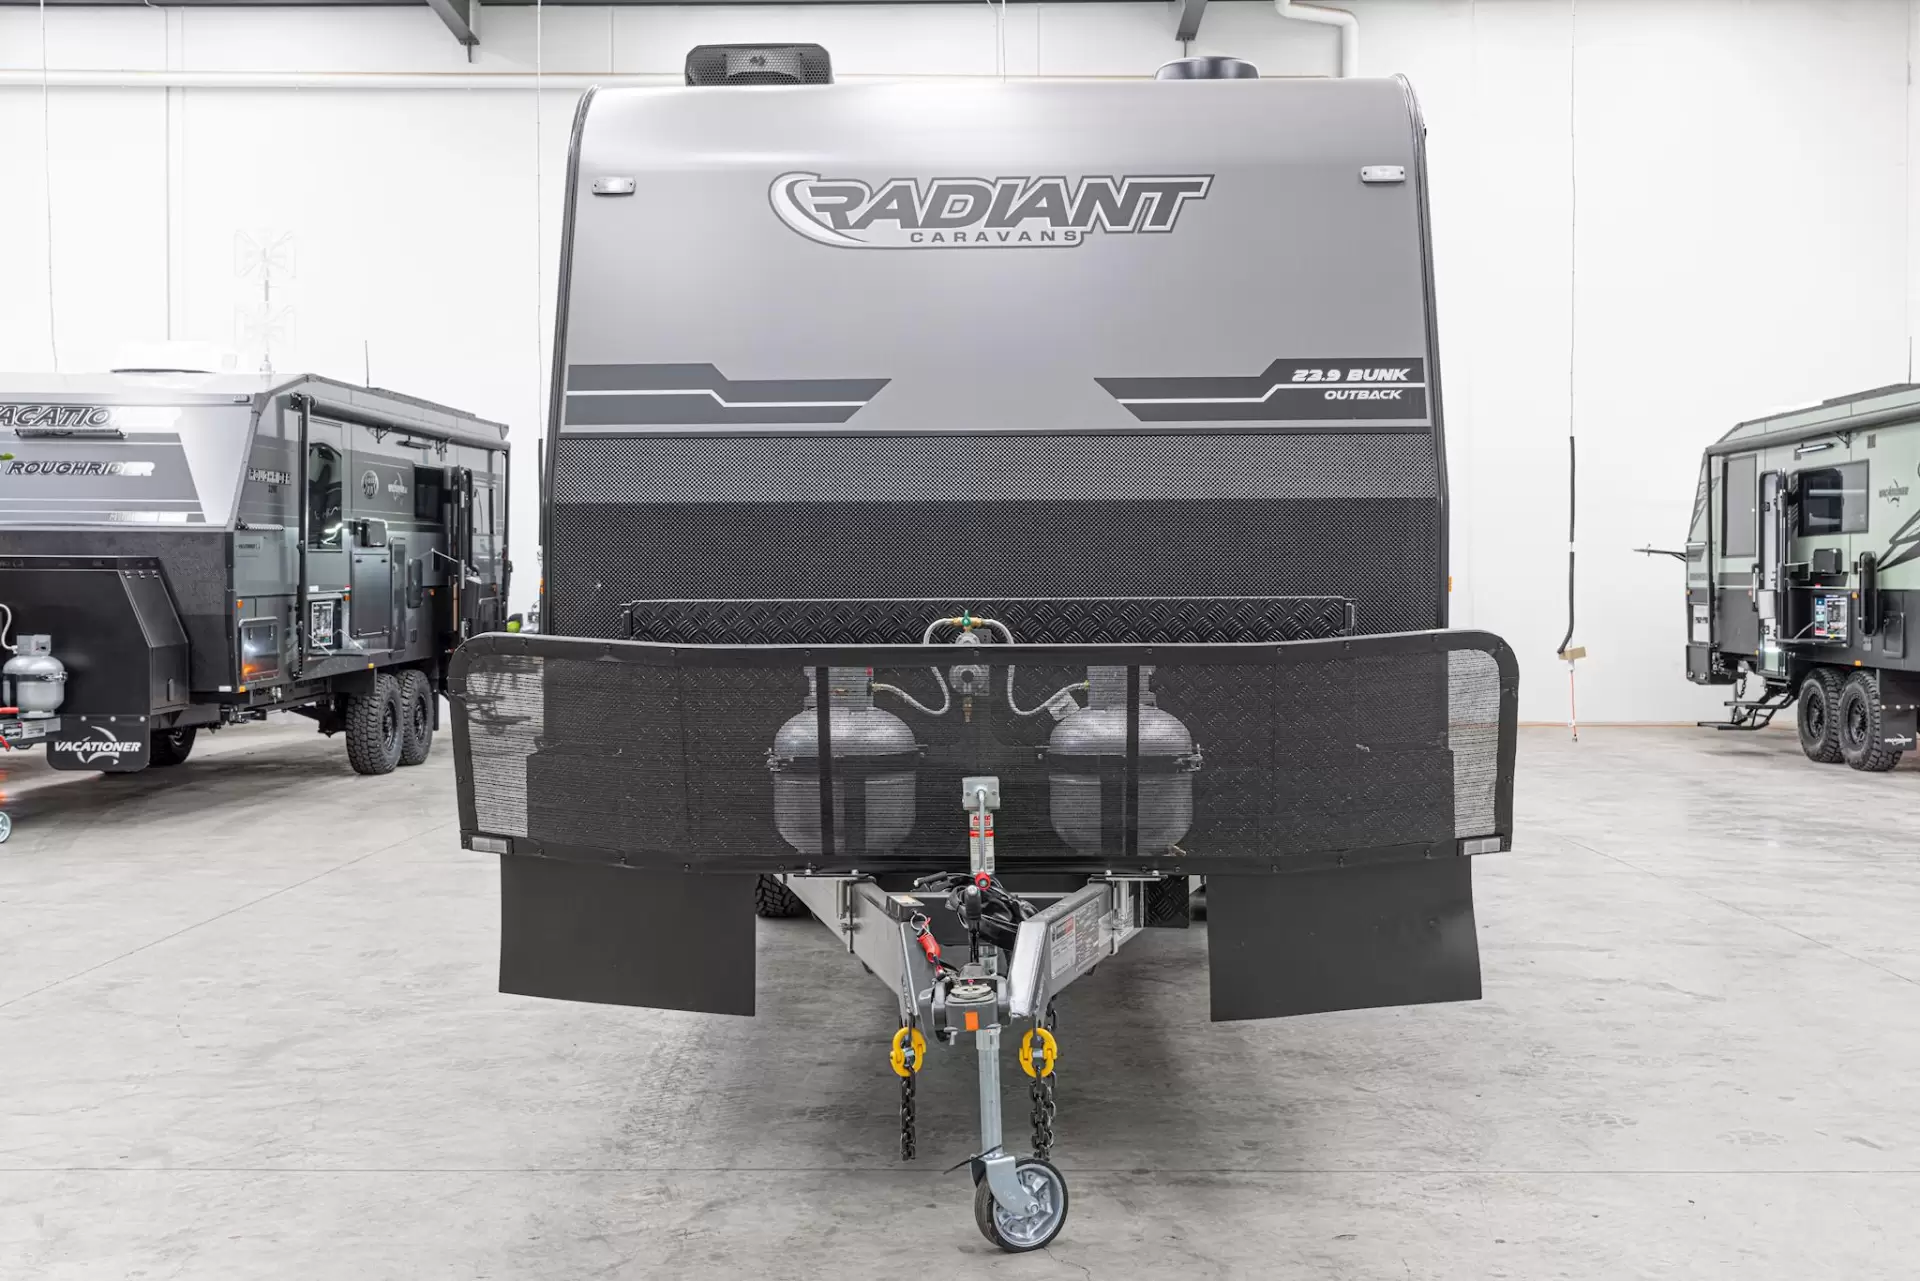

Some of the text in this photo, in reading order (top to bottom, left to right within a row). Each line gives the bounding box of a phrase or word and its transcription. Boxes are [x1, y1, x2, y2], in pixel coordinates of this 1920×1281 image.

[804, 177, 1209, 233] RADIANT
[910, 230, 1078, 243] CARAVANS
[1291, 368, 1411, 382] 23.9 BUNK
[1324, 389, 1404, 401] OUTBACK
[0, 405, 181, 428] ACATIO
[5, 460, 156, 477] ROUGHRIDR
[54, 740, 142, 752] VACATIONER
